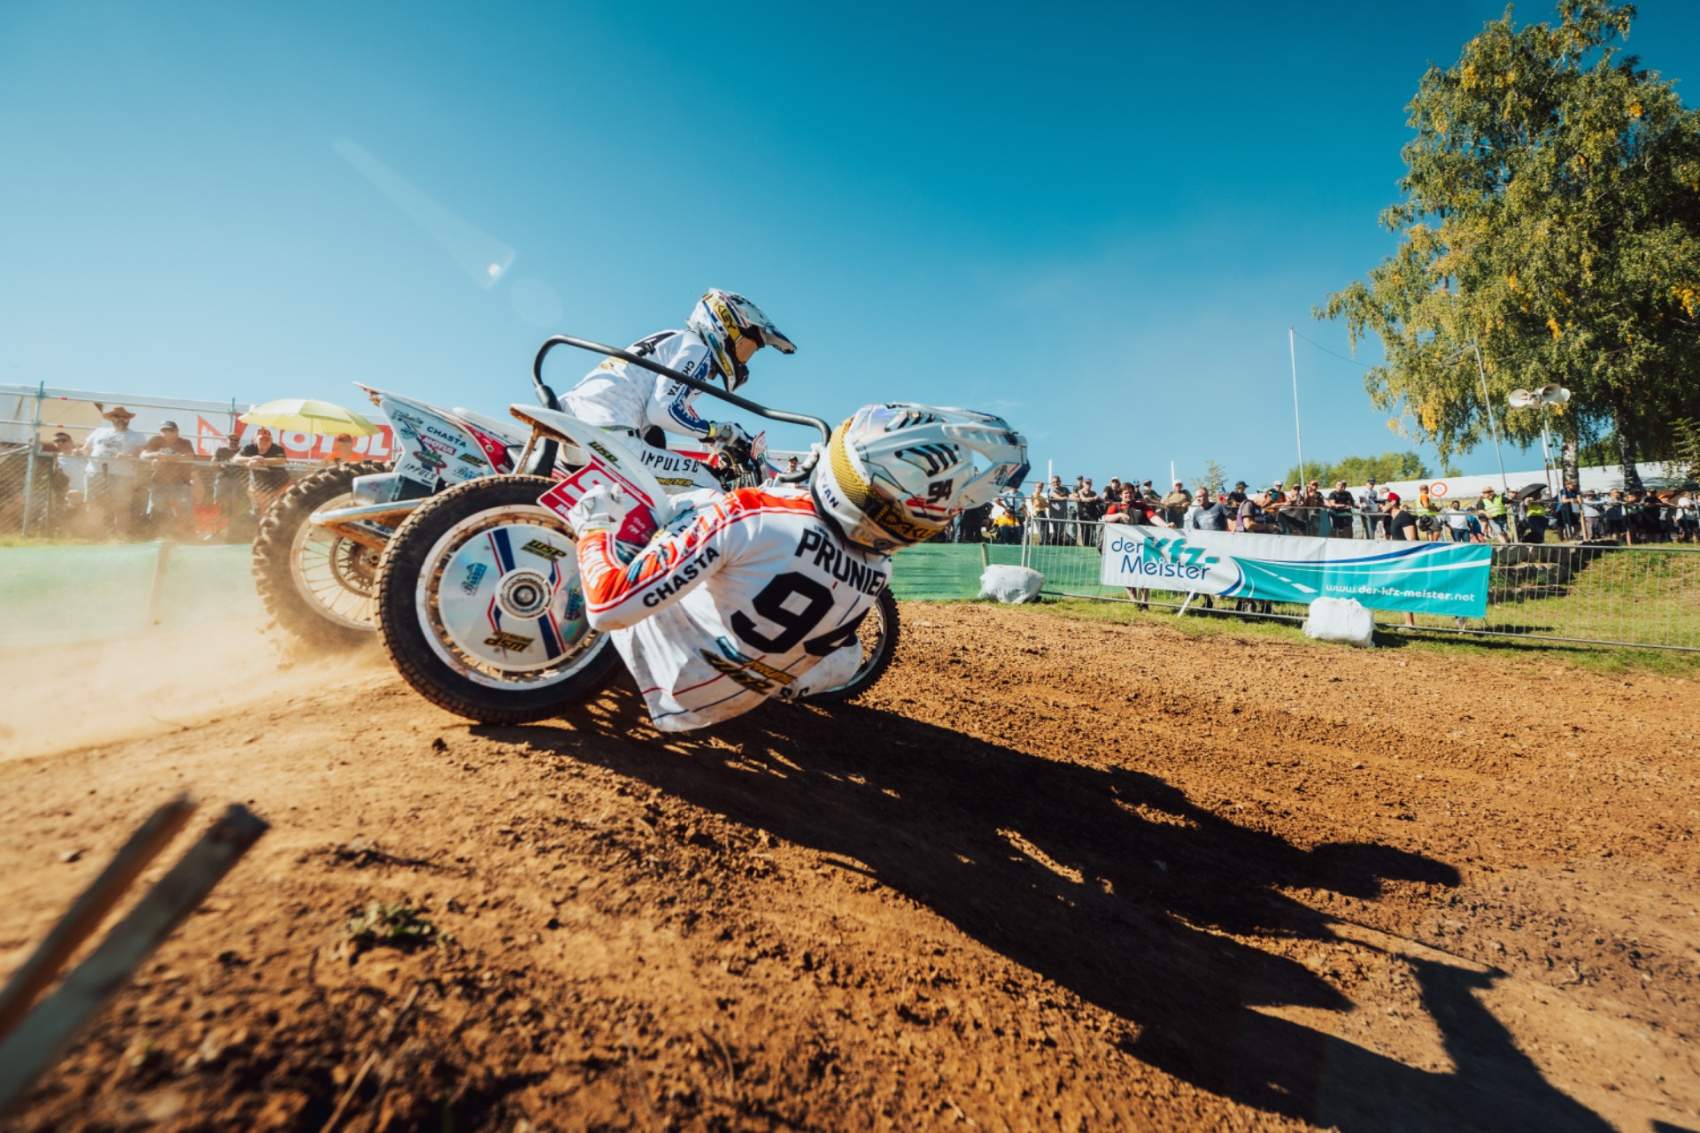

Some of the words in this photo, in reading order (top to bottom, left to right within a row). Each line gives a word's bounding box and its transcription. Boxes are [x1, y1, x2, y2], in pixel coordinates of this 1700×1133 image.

[426, 426, 467, 448] CHASTA
[640, 450, 700, 473] IMPULSE
[927, 479, 953, 504] 94
[1111, 536, 1143, 553] der
[1143, 536, 1220, 569] Kfz-
[642, 546, 720, 608] CHASTA
[1120, 555, 1211, 580] Meister
[1325, 583, 1475, 602] www.der-kfz-meister.net
